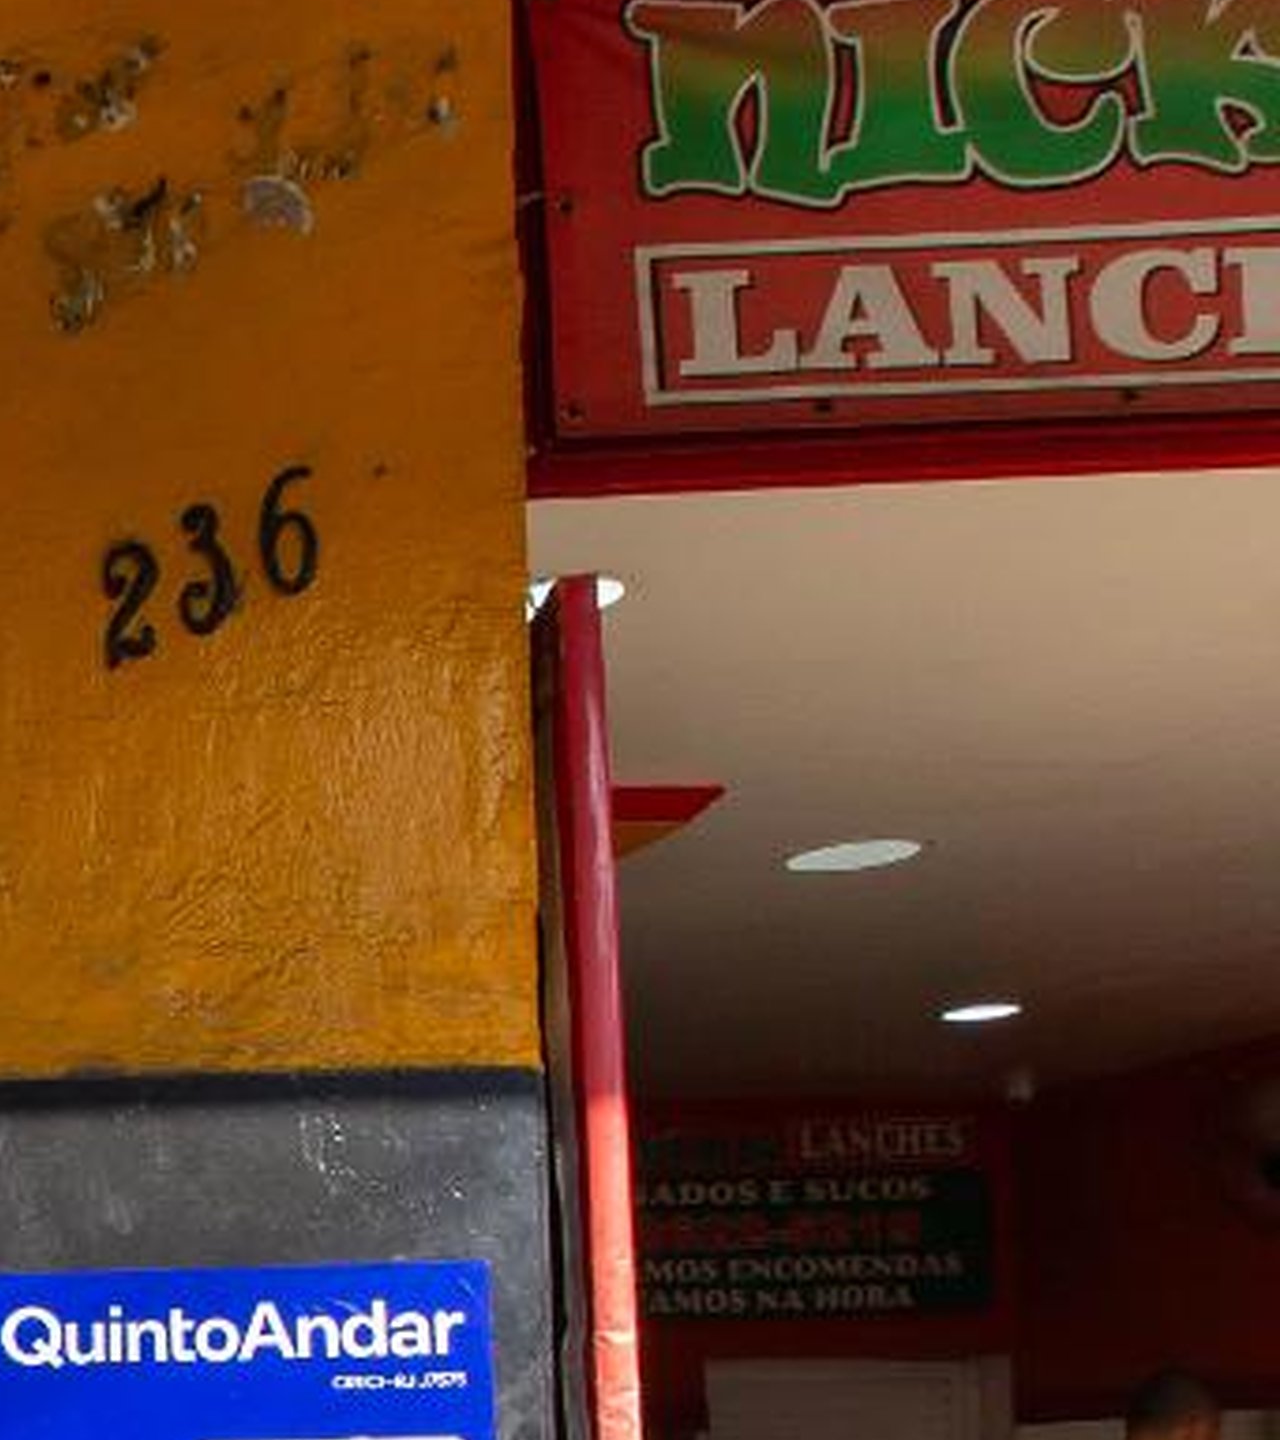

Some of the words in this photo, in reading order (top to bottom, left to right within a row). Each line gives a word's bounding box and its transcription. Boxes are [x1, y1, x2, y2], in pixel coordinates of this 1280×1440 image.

[101, 465, 320, 669] 236
[800, 1119, 964, 1160] LANCHES
[803, 1175, 935, 1202] SUCOS
[814, 1283, 917, 1311] HORA
[0, 1299, 467, 1370] QuintoAndar
